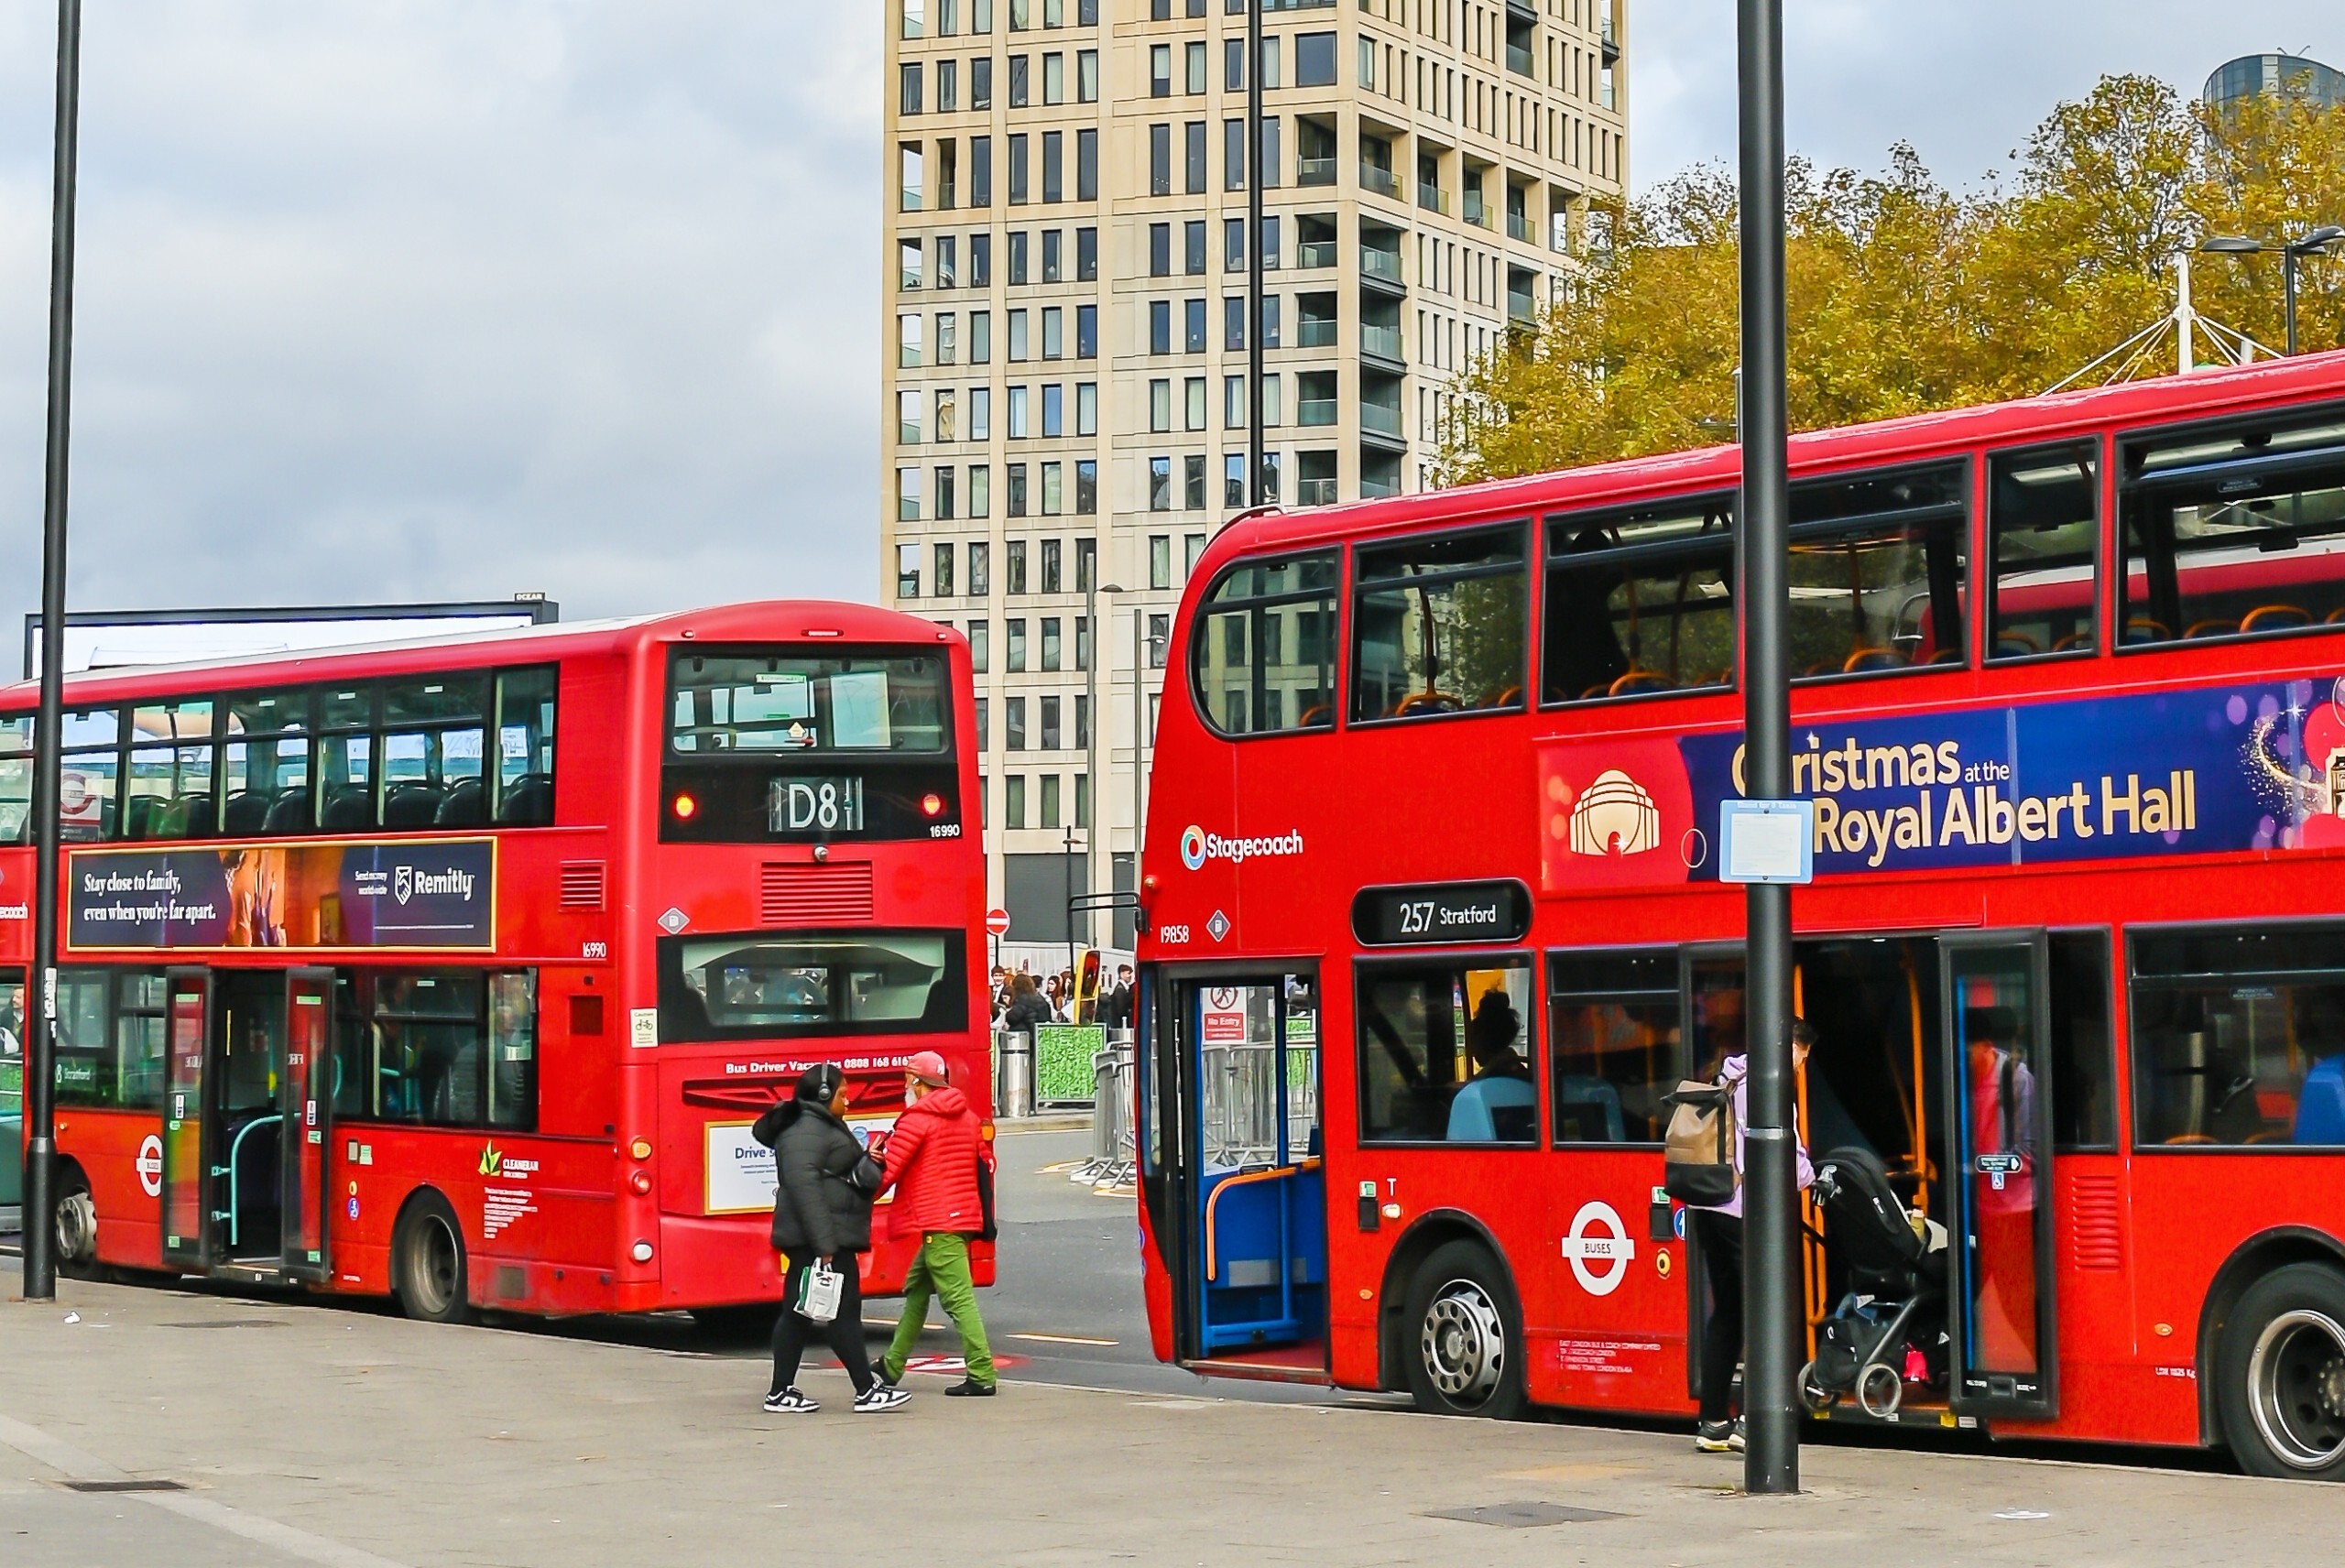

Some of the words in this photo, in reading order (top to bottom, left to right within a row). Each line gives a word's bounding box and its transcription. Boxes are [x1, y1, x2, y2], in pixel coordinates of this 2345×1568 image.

[1731, 735, 1961, 797] ristmas
[1965, 763, 1981, 783] at
[1982, 760, 2011, 781] the
[789, 782, 838, 829] D8
[1813, 790, 1933, 867] Royal
[1939, 782, 2095, 844] Albert
[2101, 769, 2196, 835] Hall
[930, 824, 960, 837] 16990
[1206, 829, 1303, 864] Stagecoach
[84, 873, 107, 897] Stay
[107, 871, 133, 892] close
[134, 876, 145, 891] to
[147, 869, 181, 895] family,
[415, 867, 472, 901] Remitly
[84, 907, 107, 921] even
[108, 899, 135, 920] when
[136, 900, 168, 925] you're
[169, 898, 185, 920] far
[185, 903, 216, 925] apart.
[1400, 901, 1435, 932] 257
[1440, 905, 1497, 924] Stratford
[1160, 925, 1190, 943] 19858
[583, 942, 606, 958] 16990
[1219, 1017, 1240, 1028] Entry
[725, 1062, 747, 1074] Bus
[749, 1061, 785, 1073] Driver
[844, 1058, 869, 1070] 0808
[872, 1056, 889, 1068] 168
[735, 1146, 767, 1160] Drive
[1585, 1243, 1611, 1254] BUSES
